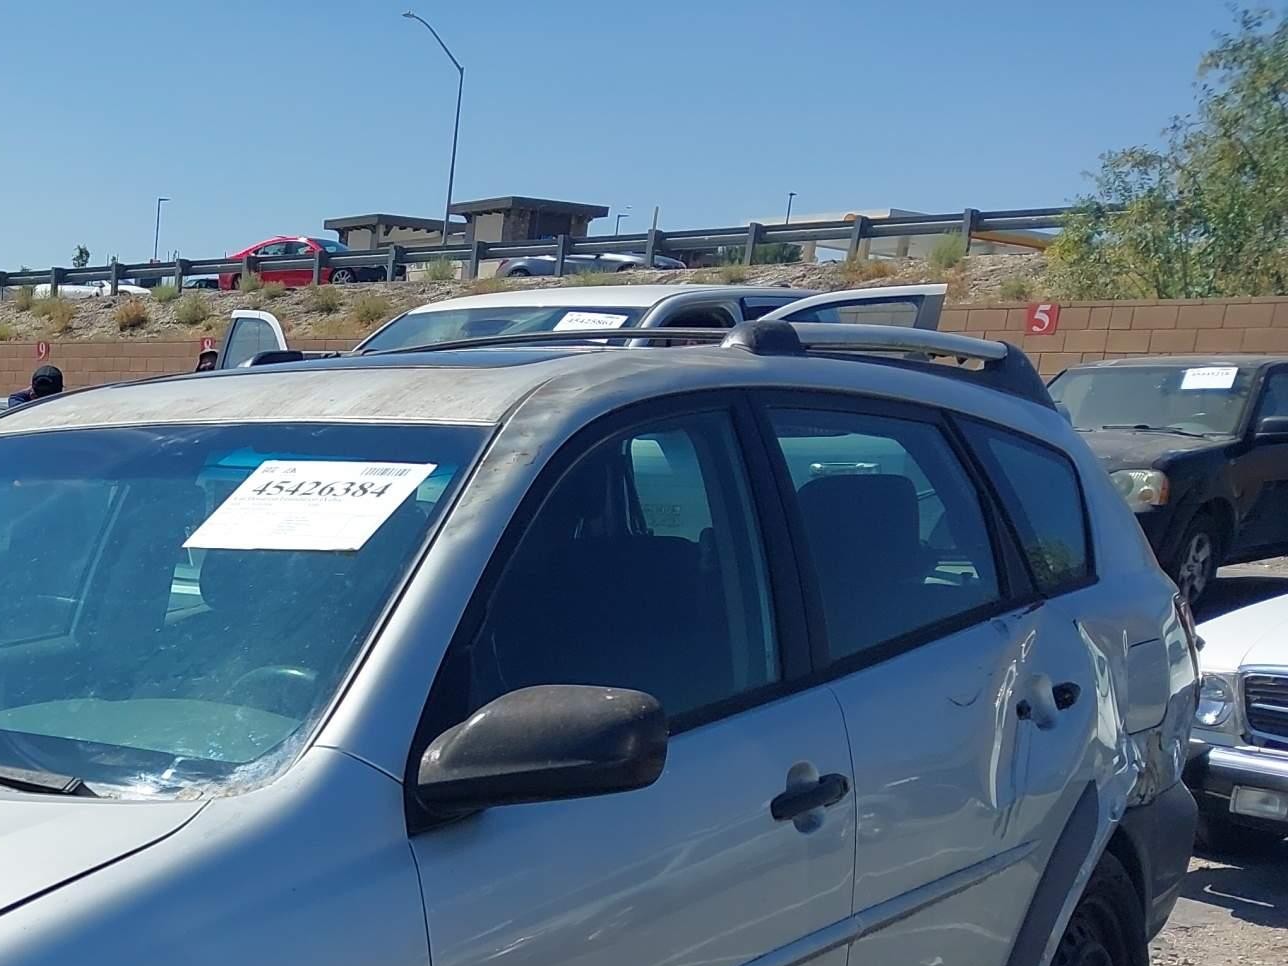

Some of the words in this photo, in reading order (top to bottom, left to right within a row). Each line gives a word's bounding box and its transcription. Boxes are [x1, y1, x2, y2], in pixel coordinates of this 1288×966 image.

[1032, 304, 1051, 331] 5
[39, 342, 46, 360] 9
[252, 479, 394, 498] 45426384
